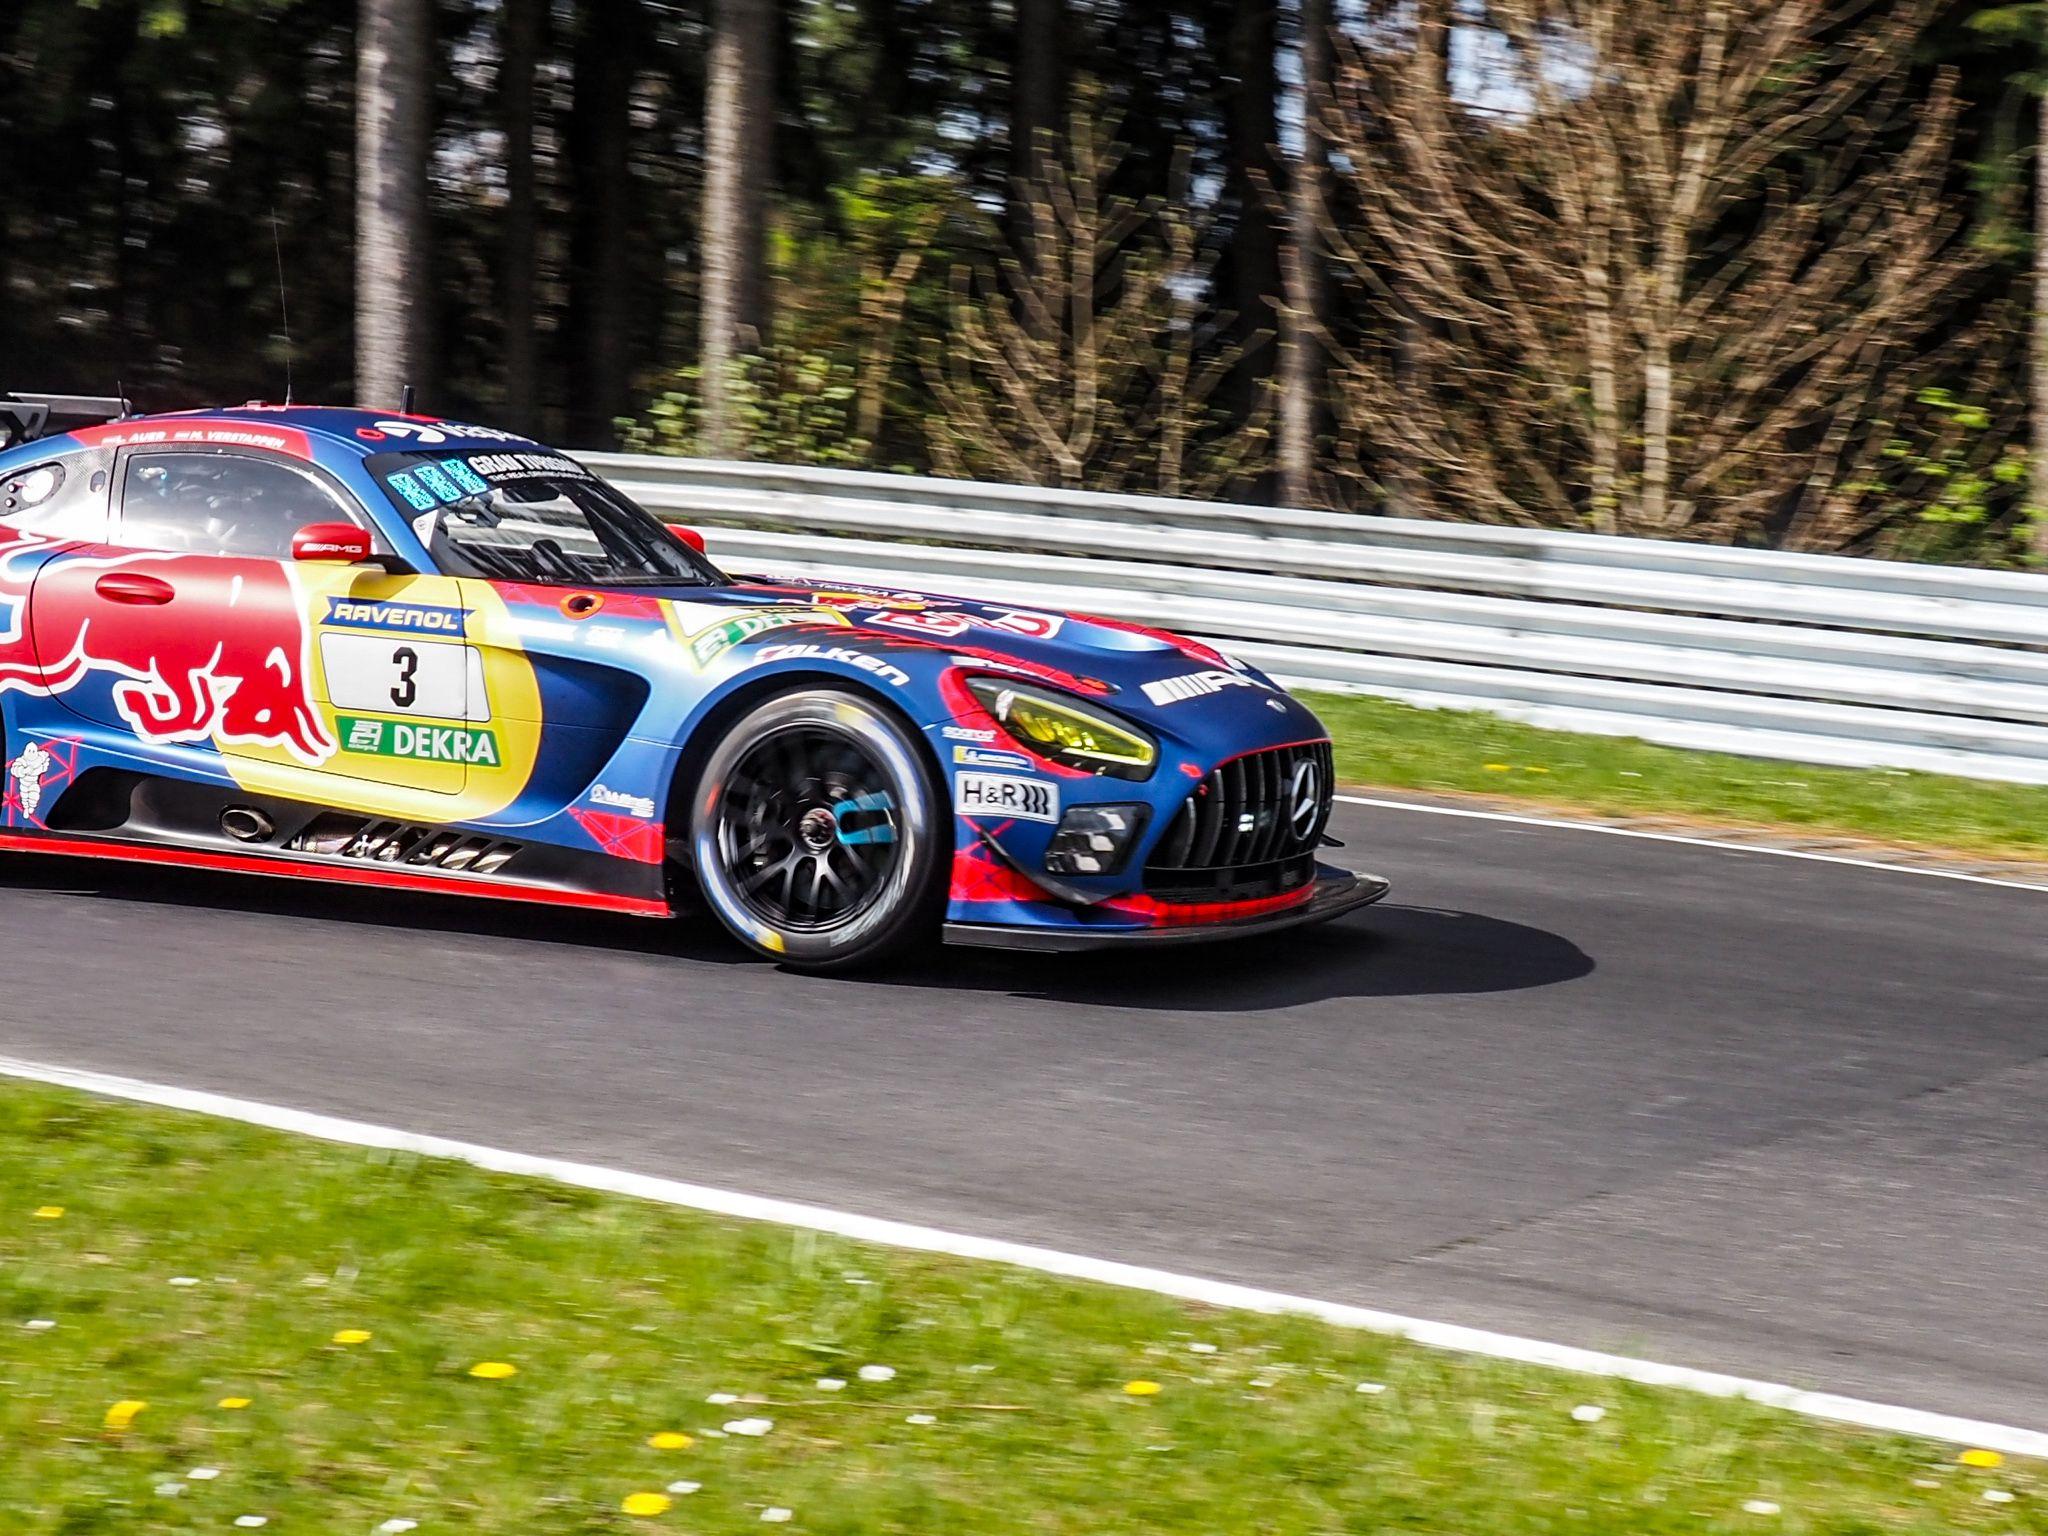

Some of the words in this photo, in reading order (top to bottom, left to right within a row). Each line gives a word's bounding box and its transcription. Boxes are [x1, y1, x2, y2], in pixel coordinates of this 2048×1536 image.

[128, 431, 167, 443] AUER
[207, 431, 286, 448] VERSTAPPEN
[467, 454, 524, 475] GRAN
[321, 543, 362, 553] AMG
[333, 602, 458, 631] RAVENOL
[389, 646, 418, 708] 3
[752, 644, 911, 687] FALKEN
[394, 724, 497, 765] DEKRA
[963, 780, 1018, 807] H&R
